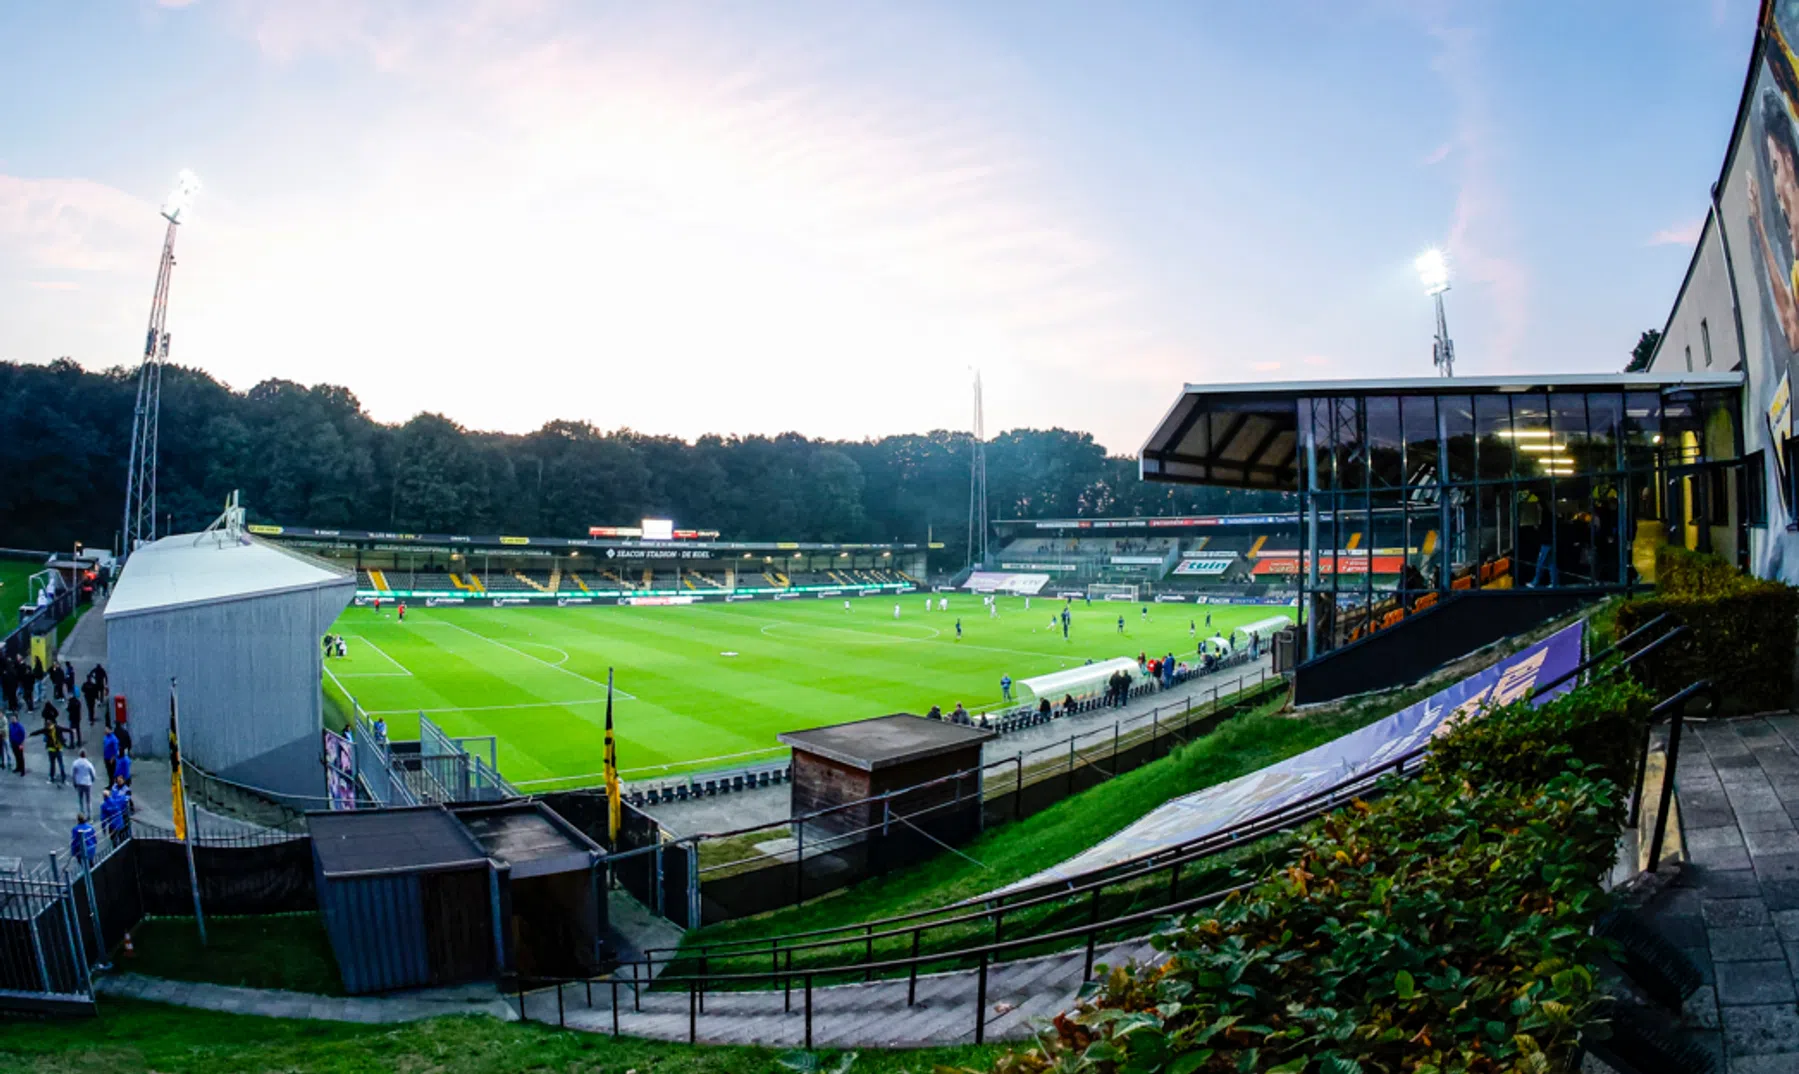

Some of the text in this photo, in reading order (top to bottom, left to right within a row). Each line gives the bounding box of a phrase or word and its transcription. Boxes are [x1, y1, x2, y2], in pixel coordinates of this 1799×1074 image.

[616, 550, 645, 558] SEACON
[645, 550, 678, 558] STADION
[681, 550, 692, 559] DE
[1189, 561, 1228, 570] tuin
